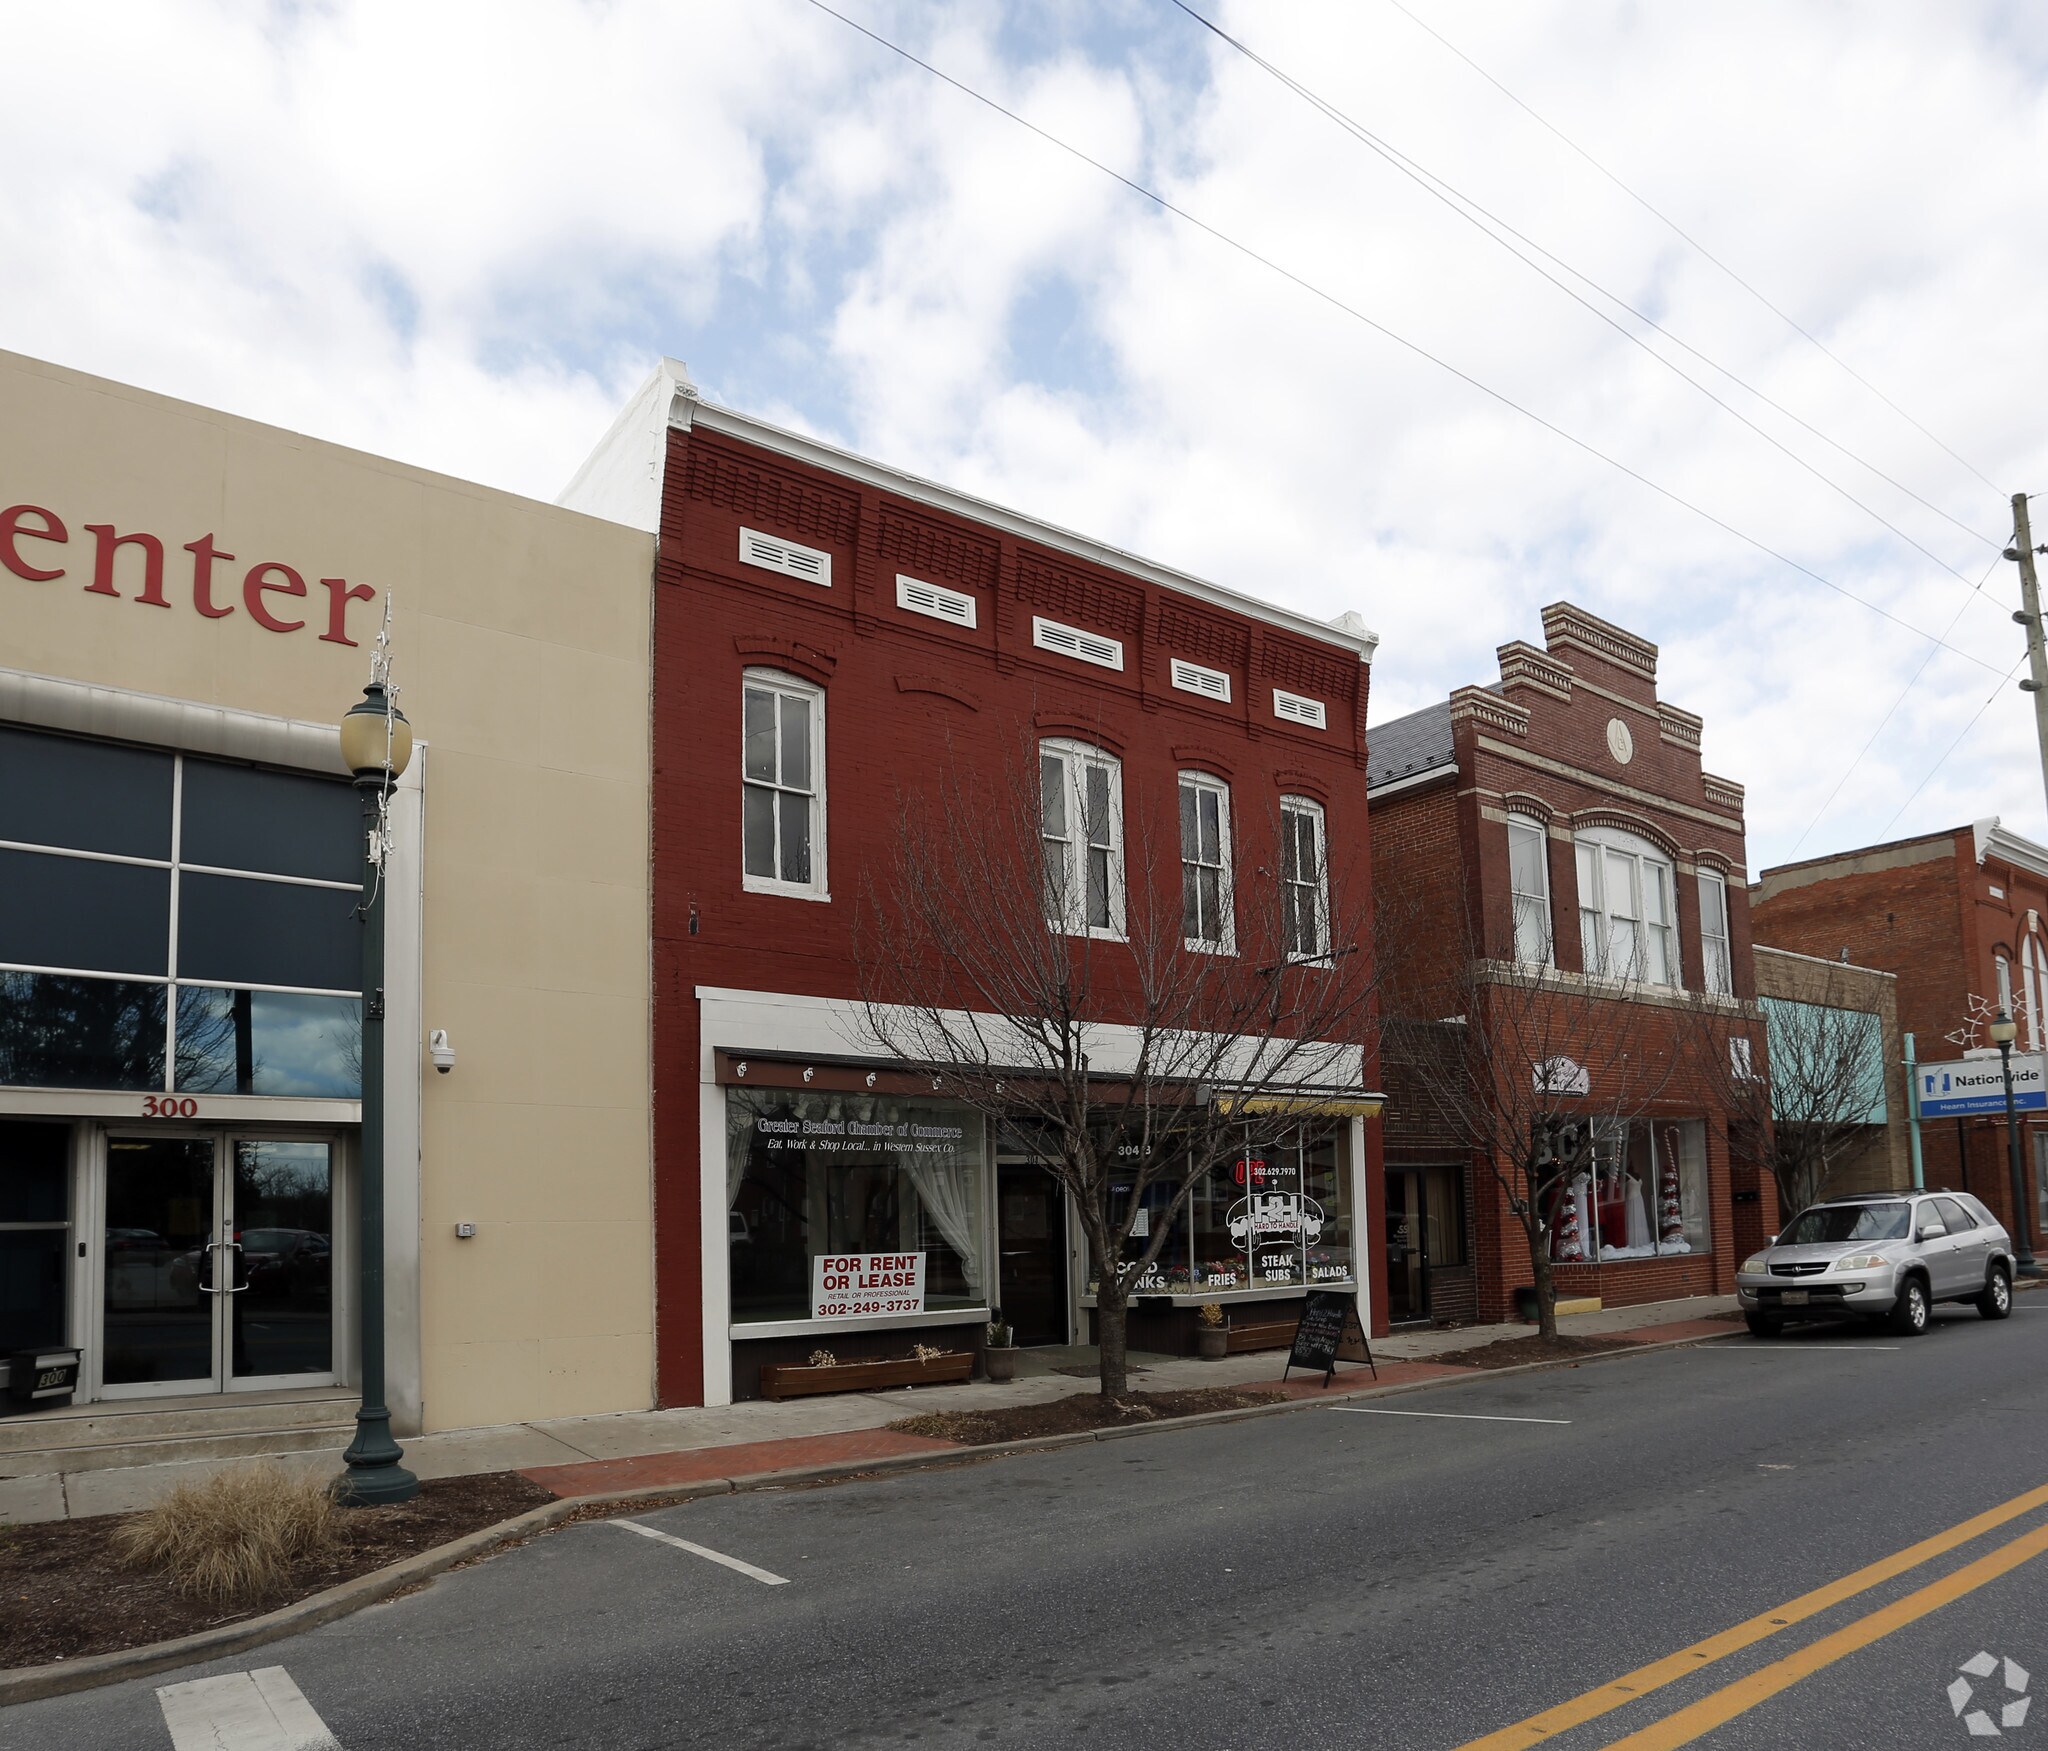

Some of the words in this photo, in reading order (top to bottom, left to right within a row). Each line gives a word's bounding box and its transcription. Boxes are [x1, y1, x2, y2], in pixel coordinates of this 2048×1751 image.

[142, 1095, 198, 1119] 300
[1940, 1103, 1966, 1111] Hearn
[757, 1117, 799, 1133] Greater
[802, 1119, 845, 1135] Seaford
[847, 1121, 894, 1136] Chamber
[897, 1122, 908, 1136] of
[910, 1123, 963, 1138] Commerce
[787, 1139, 807, 1149] Work
[809, 1141, 816, 1149] &
[818, 1140, 840, 1152] Shop
[842, 1141, 870, 1151] Local...
[873, 1141, 881, 1151] in
[884, 1142, 913, 1152] Western
[915, 1143, 941, 1152] Sussex
[943, 1143, 955, 1153] Co.
[1118, 1145, 1140, 1155] 304
[1253, 1167, 1296, 1176] 302.629.7970
[1254, 1195, 1298, 1223] H2H
[823, 1257, 862, 1273] FOR
[870, 1256, 917, 1271] RENT
[1116, 1261, 1158, 1275] COD
[1261, 1254, 1293, 1268] STEAK
[1265, 1269, 1291, 1282] SUBS
[1312, 1265, 1348, 1279] SALADS
[822, 1275, 850, 1290] OR
[858, 1272, 915, 1289] LEASE
[1207, 1273, 1237, 1287] FRIES
[863, 1290, 910, 1298] PROFESSIONAL
[818, 1299, 920, 1316] 302-249-3737
[41, 1370, 65, 1386] 300
